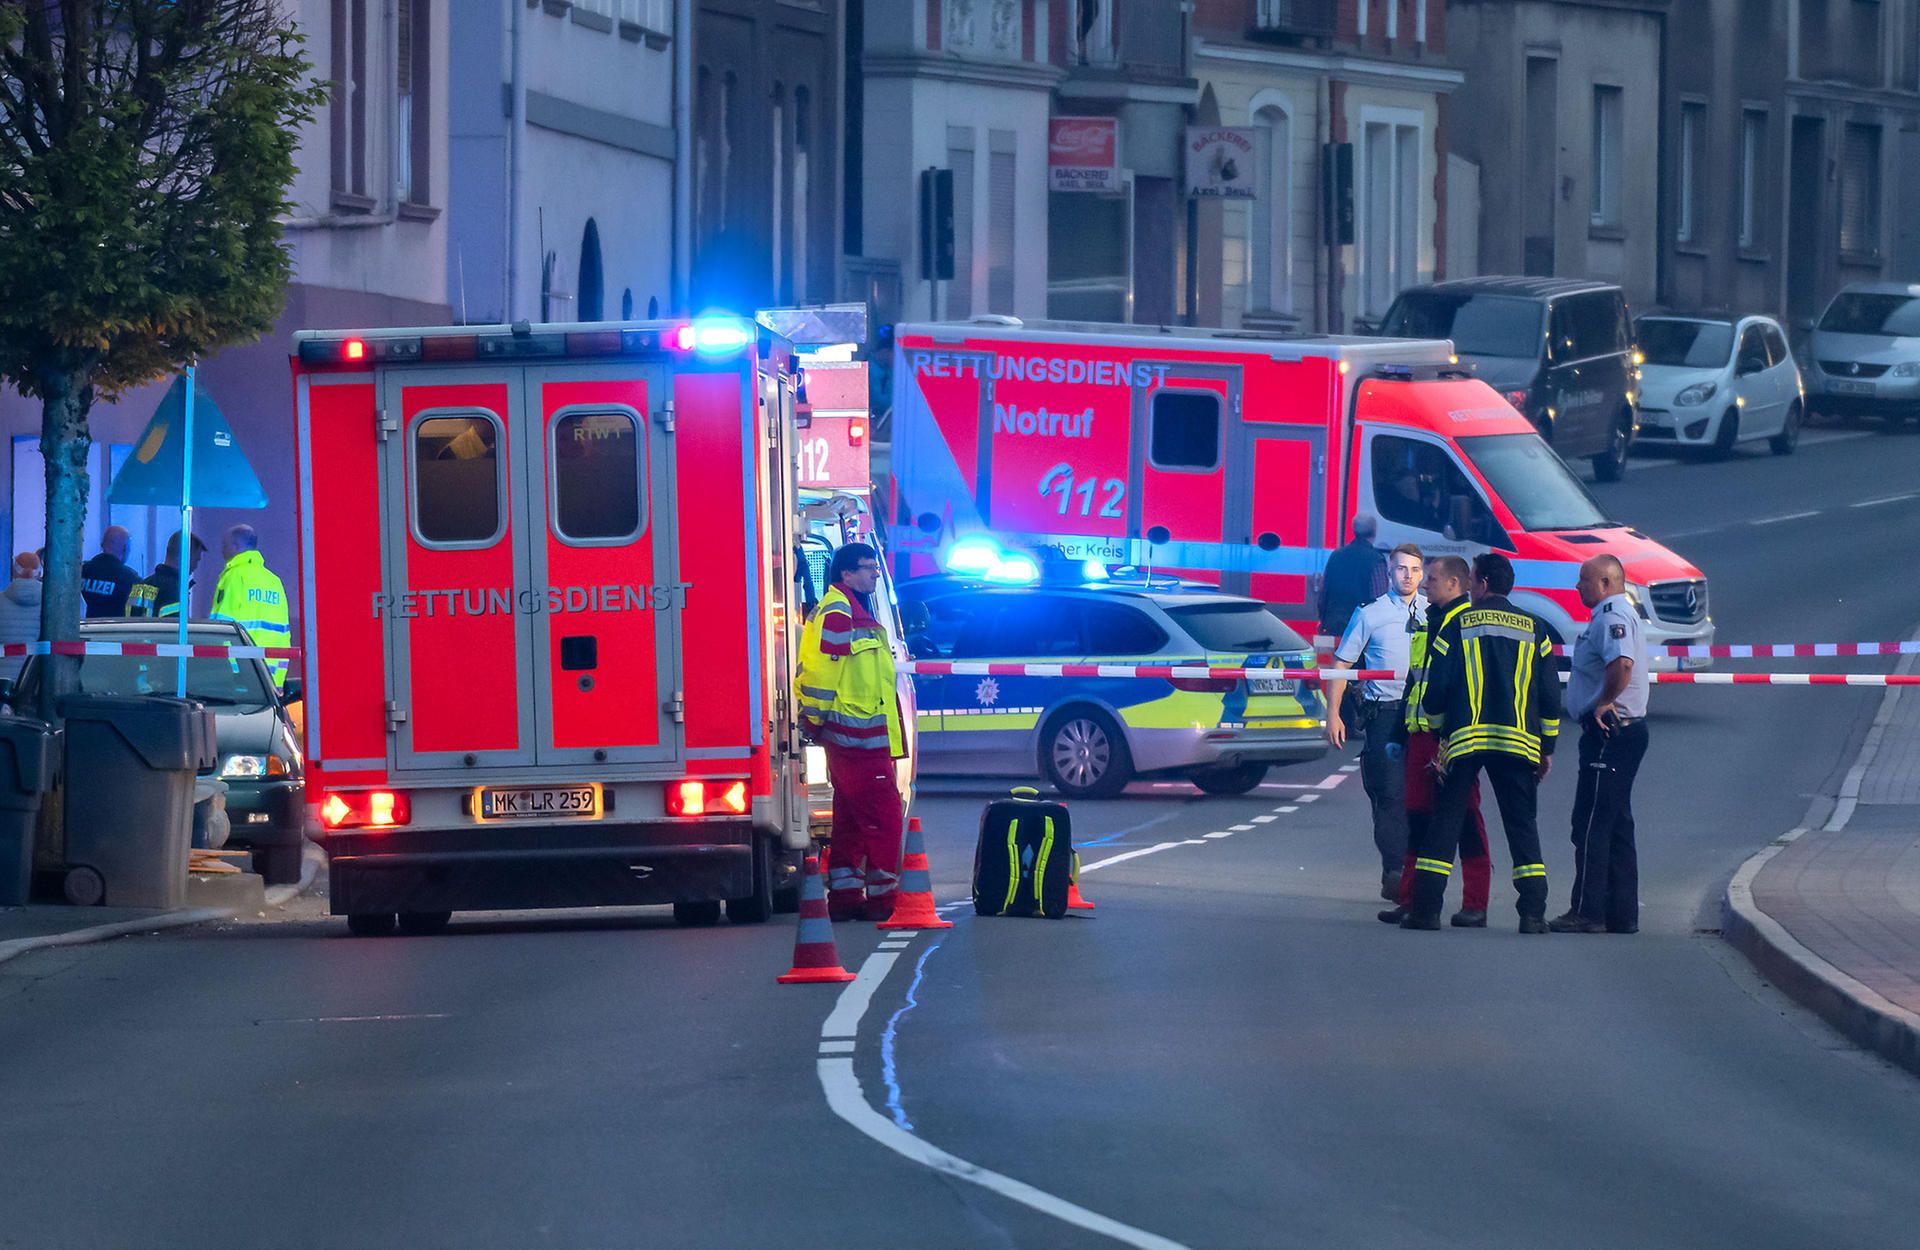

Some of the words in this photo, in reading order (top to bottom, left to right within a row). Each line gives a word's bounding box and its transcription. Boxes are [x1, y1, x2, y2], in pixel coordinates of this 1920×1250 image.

[913, 352, 1171, 388] RETTUNGSDIENST
[994, 403, 1094, 438] Notruf
[797, 437, 830, 481] 112
[1054, 476, 1125, 518] 112
[1086, 543, 1124, 559] Kreis
[371, 582, 693, 619] RETTUNGSDIENST
[1462, 611, 1532, 630] FEUERWEHR
[495, 793, 518, 811] MK
[531, 792, 554, 811] LR
[559, 790, 593, 810] 259
